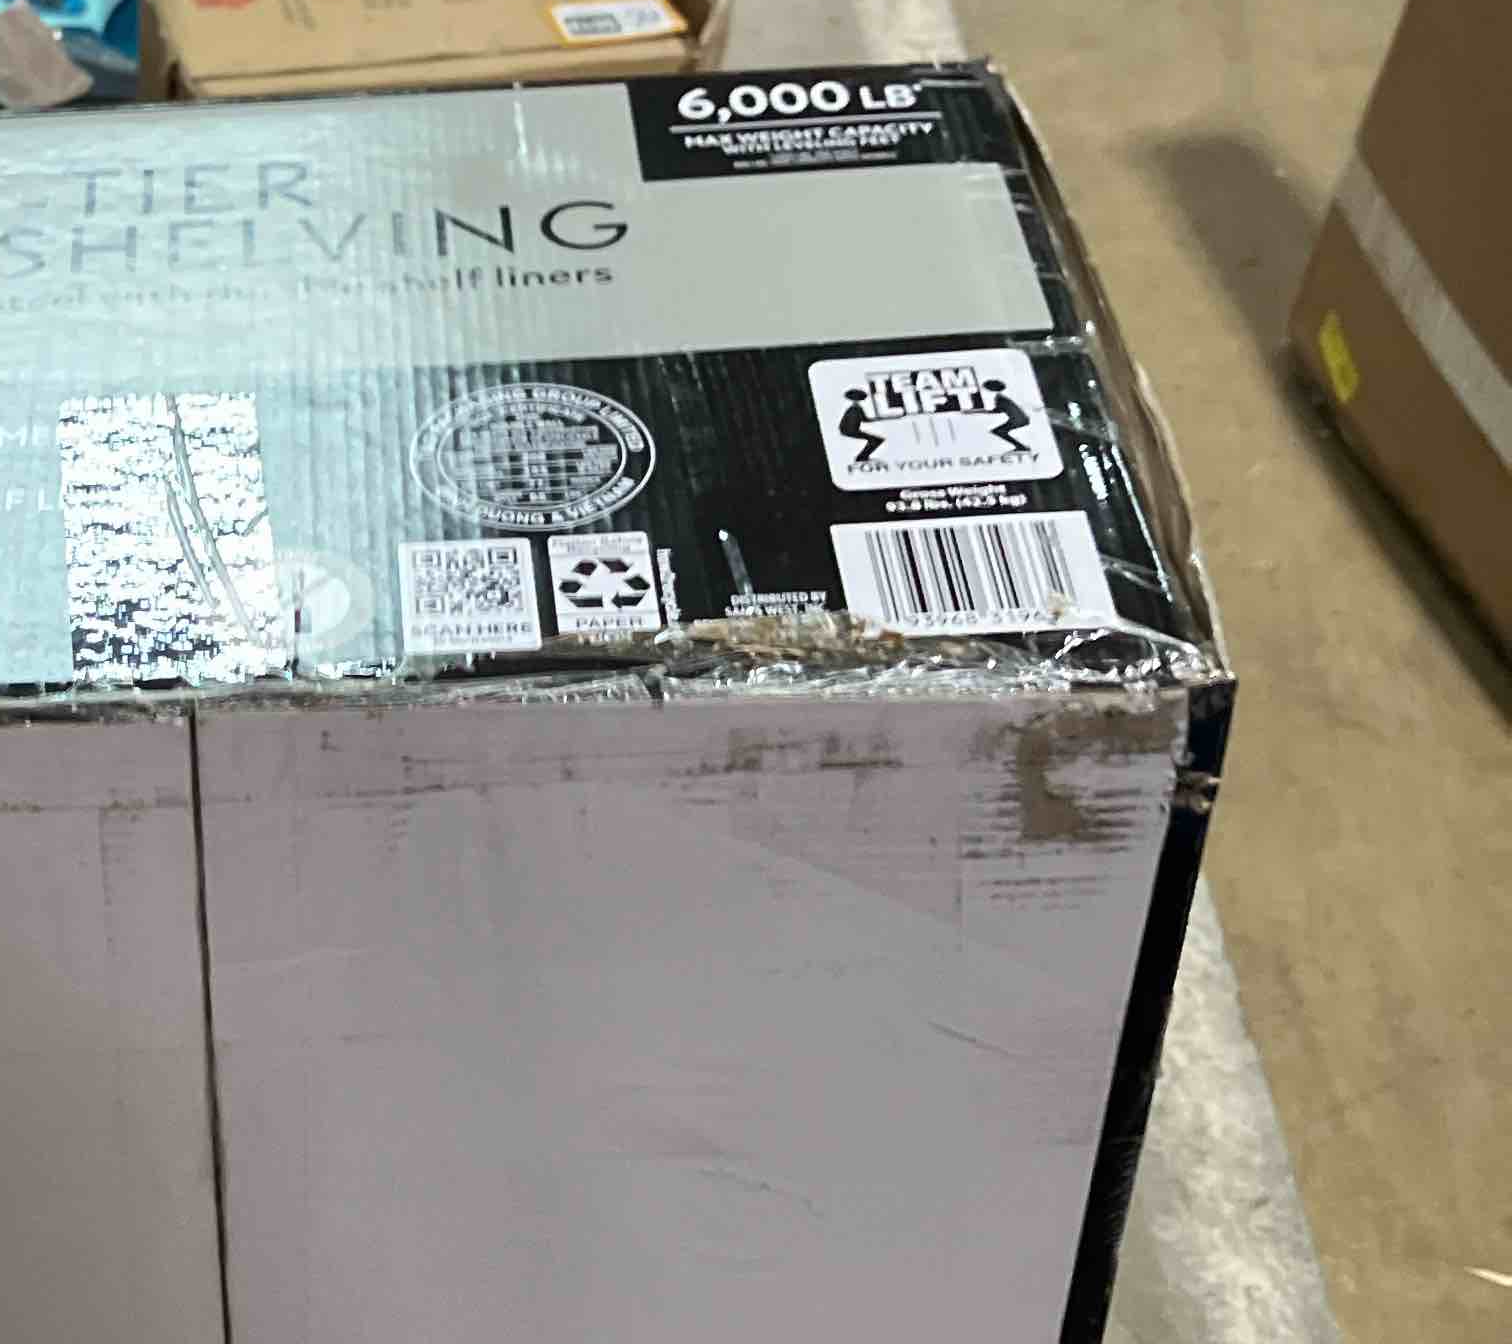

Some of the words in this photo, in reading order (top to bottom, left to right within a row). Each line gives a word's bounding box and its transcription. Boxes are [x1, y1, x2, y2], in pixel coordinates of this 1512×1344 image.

[676, 80, 851, 124] 6,000
[495, 263, 614, 288] liners
[870, 366, 977, 394] TEAM
[874, 389, 997, 419] LIFT
[847, 462, 888, 475] FOR
[895, 458, 953, 473] YOUR
[958, 452, 1041, 468] SAFETY
